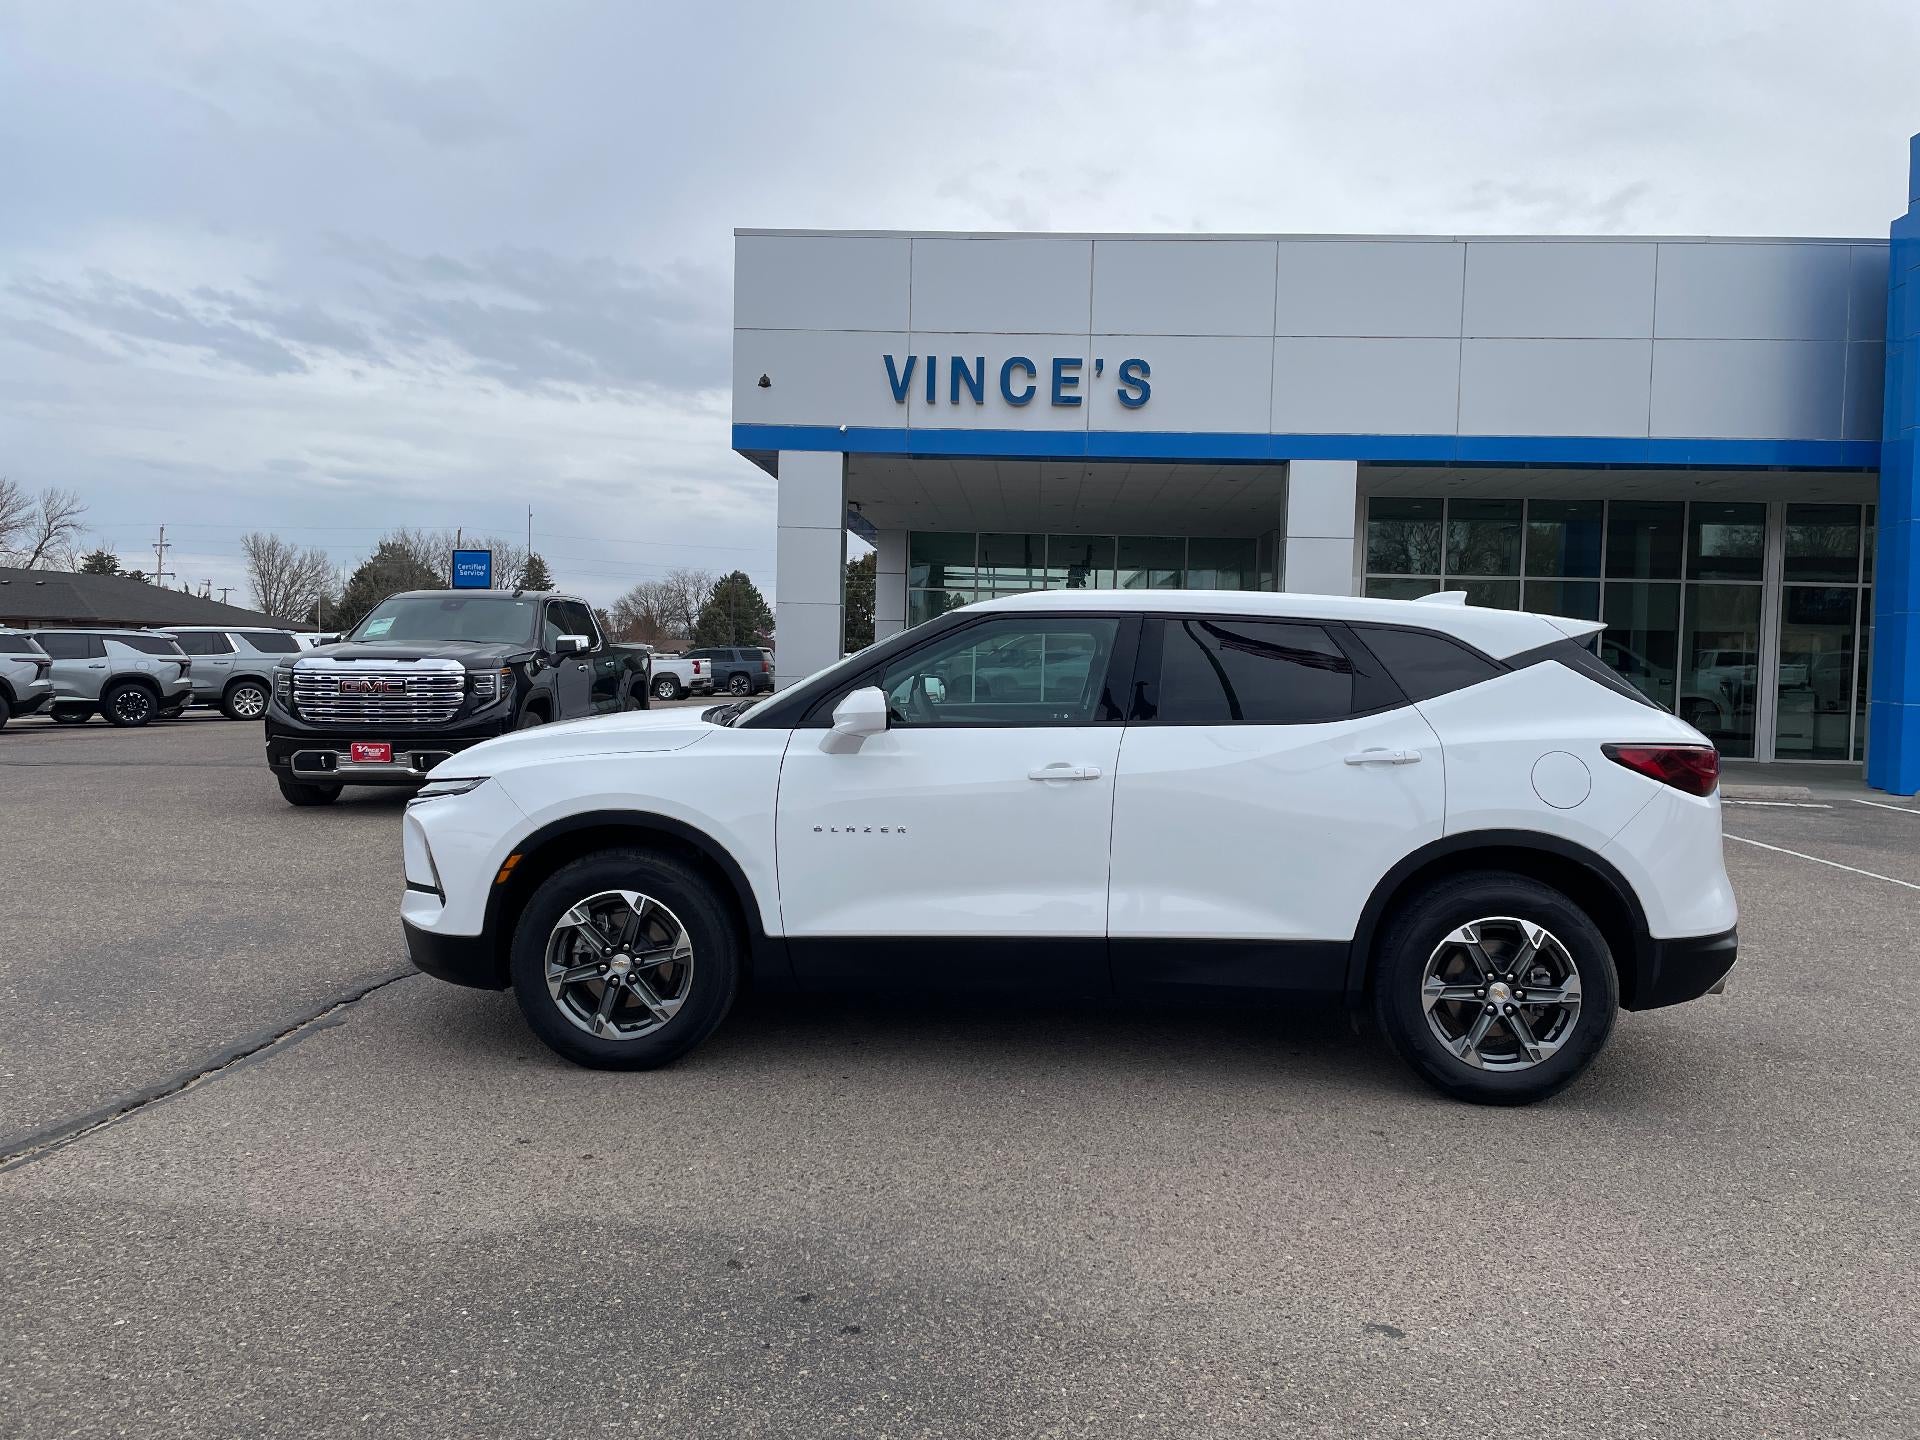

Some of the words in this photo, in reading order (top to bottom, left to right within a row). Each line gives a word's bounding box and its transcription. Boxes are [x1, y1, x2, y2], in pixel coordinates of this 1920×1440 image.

[883, 355, 1151, 409] VINCE'S
[341, 681, 403, 692] GMC
[813, 825, 906, 833] BLAZER
